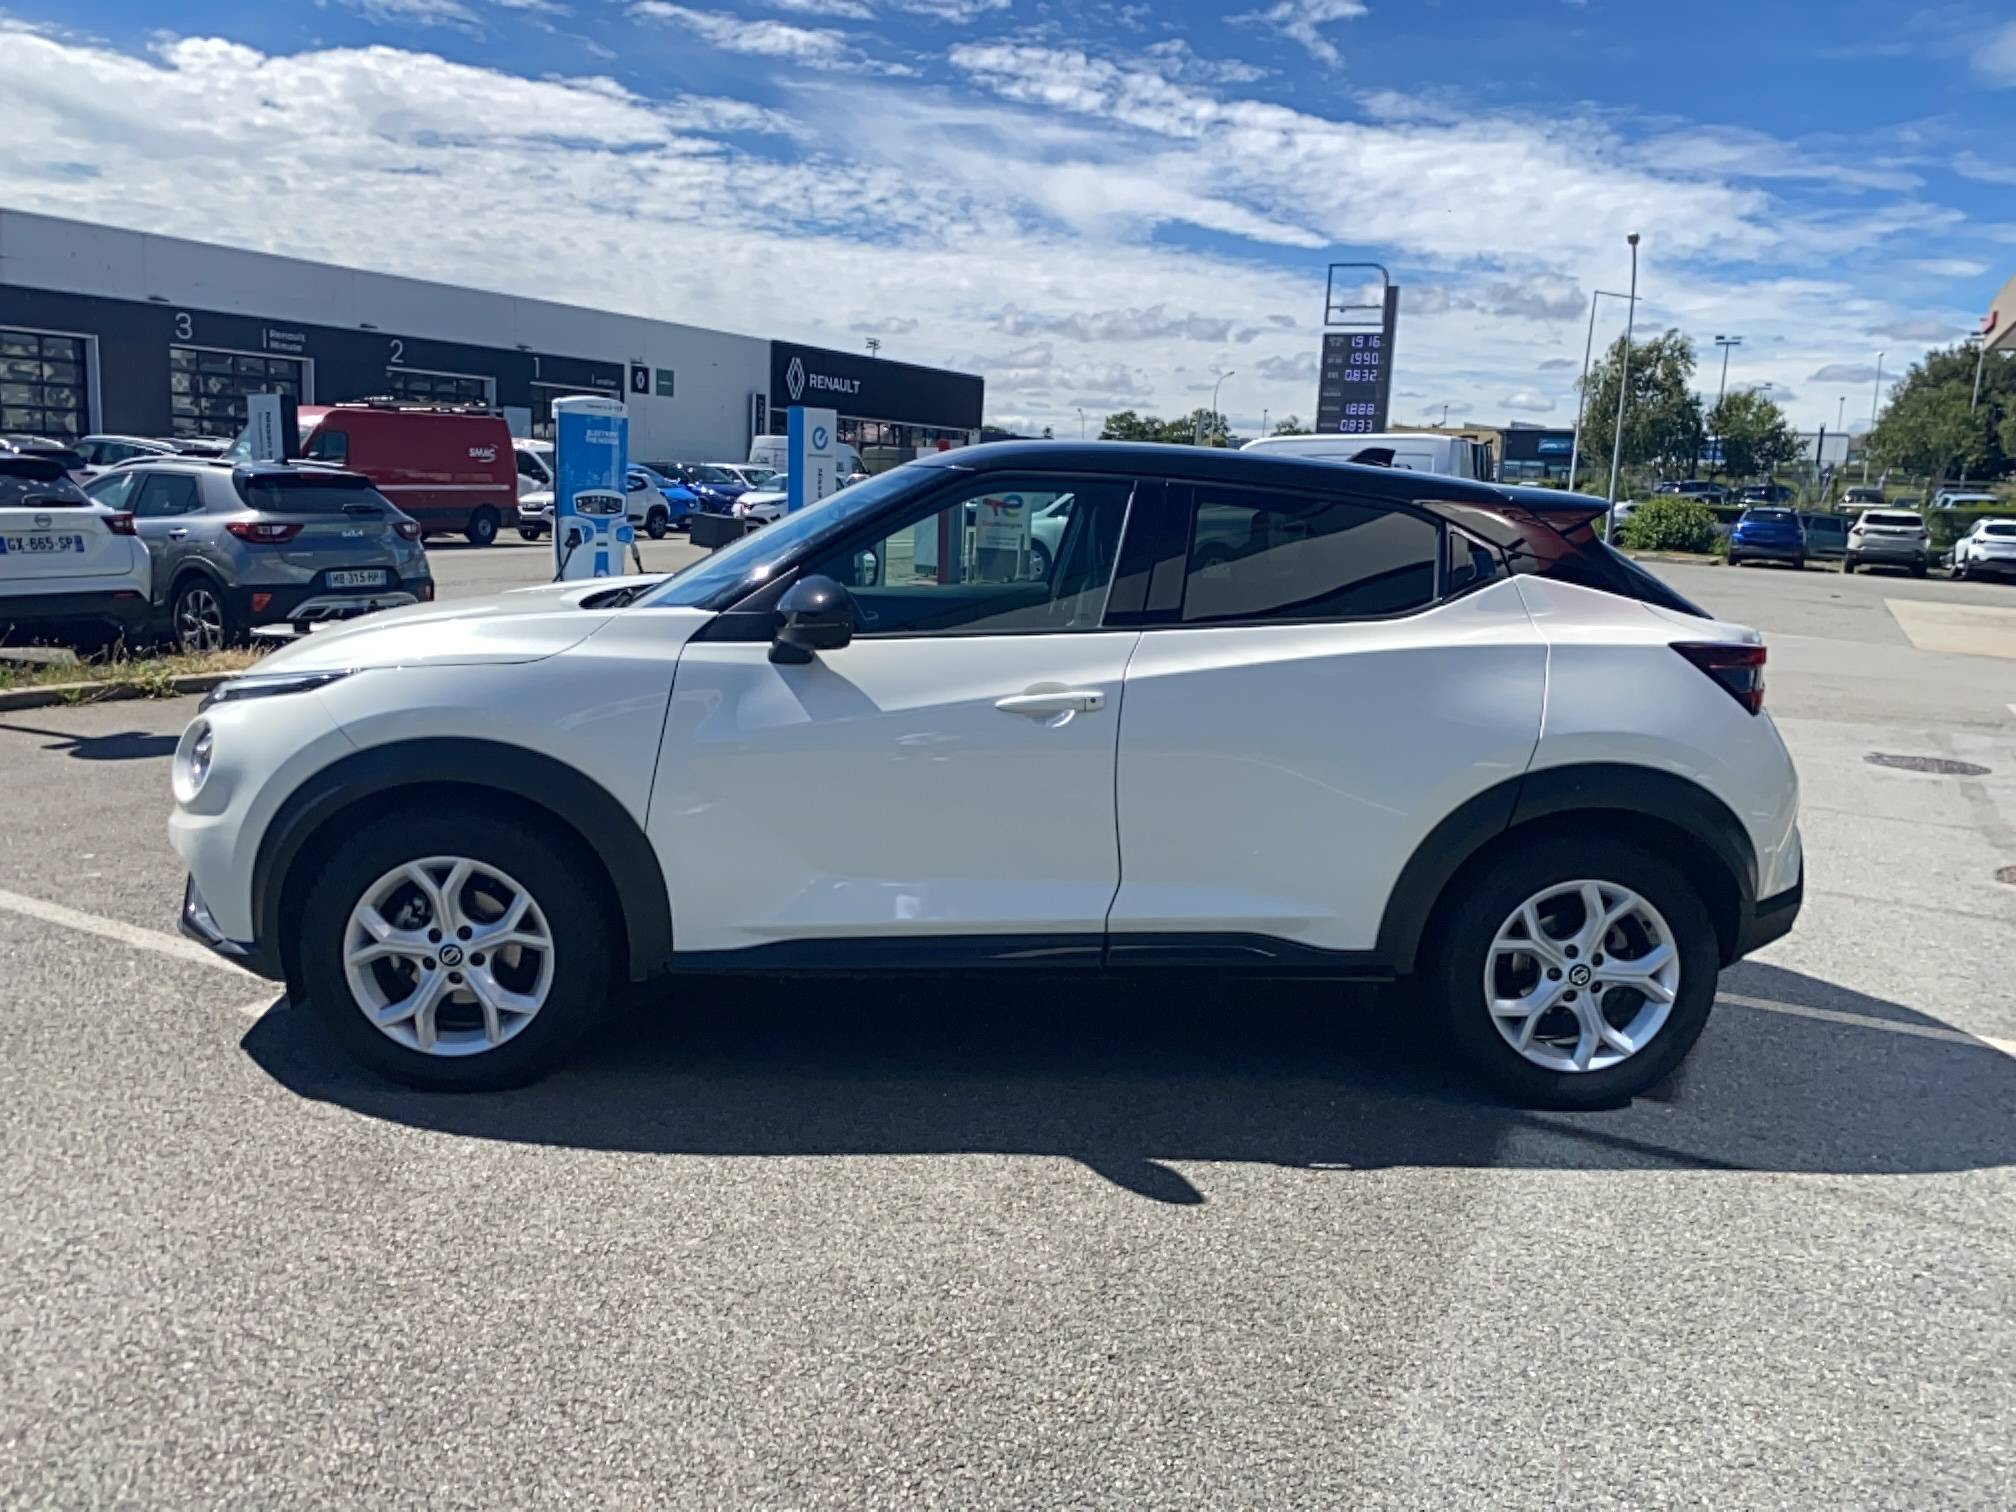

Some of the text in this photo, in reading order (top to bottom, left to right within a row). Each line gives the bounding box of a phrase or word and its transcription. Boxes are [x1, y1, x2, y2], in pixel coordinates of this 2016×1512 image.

[175, 312, 193, 340] 3
[389, 339, 404, 363] 2
[809, 373, 861, 394] RENAULT
[469, 447, 496, 458] SMAC
